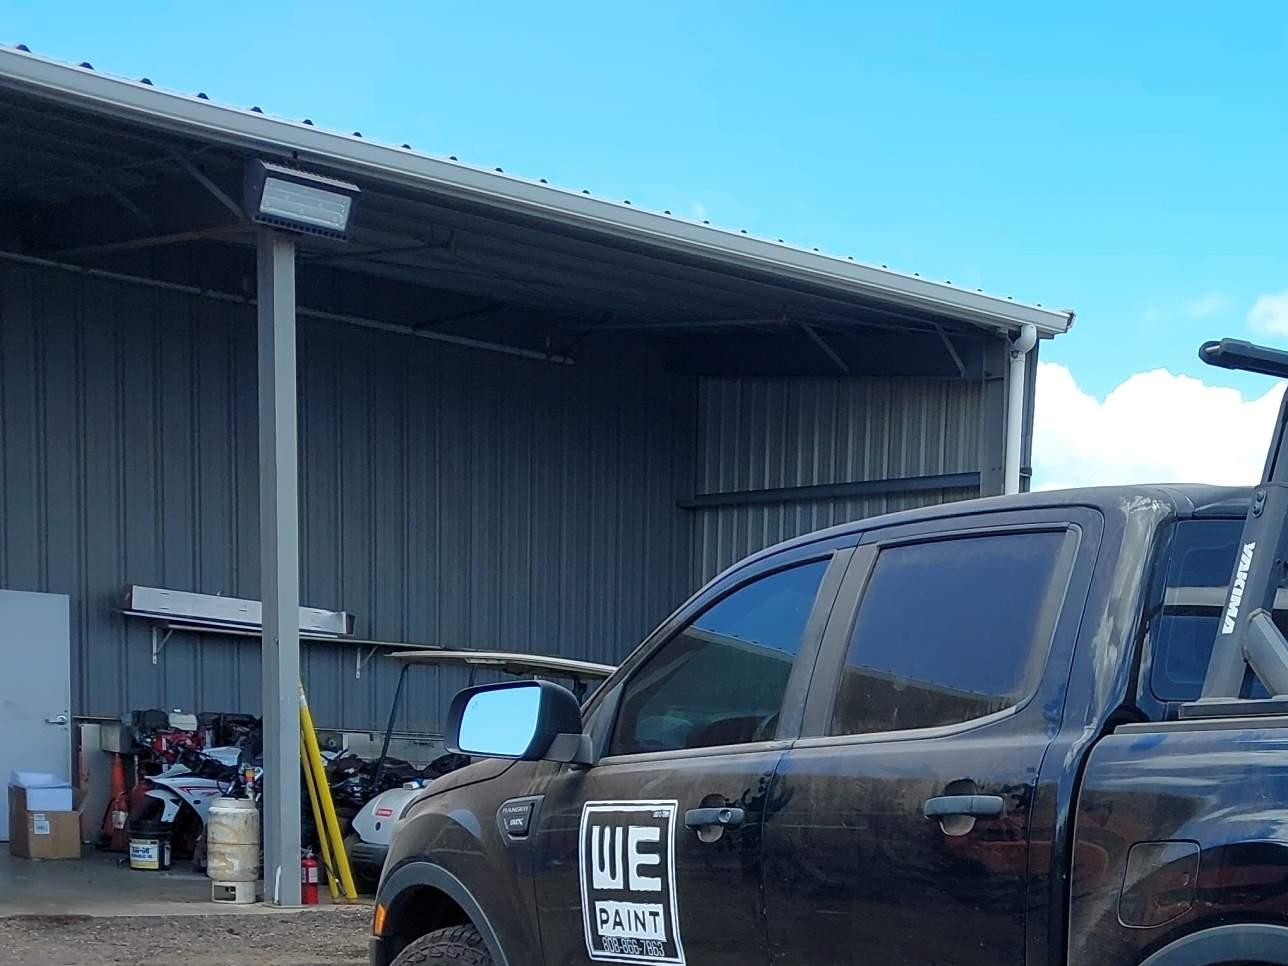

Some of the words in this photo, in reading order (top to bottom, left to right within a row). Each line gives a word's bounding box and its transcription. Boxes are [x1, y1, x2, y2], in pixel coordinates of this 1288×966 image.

[1222, 542, 1256, 634] YAKIMA
[592, 826, 662, 892] WE
[599, 907, 660, 934] PAINT
